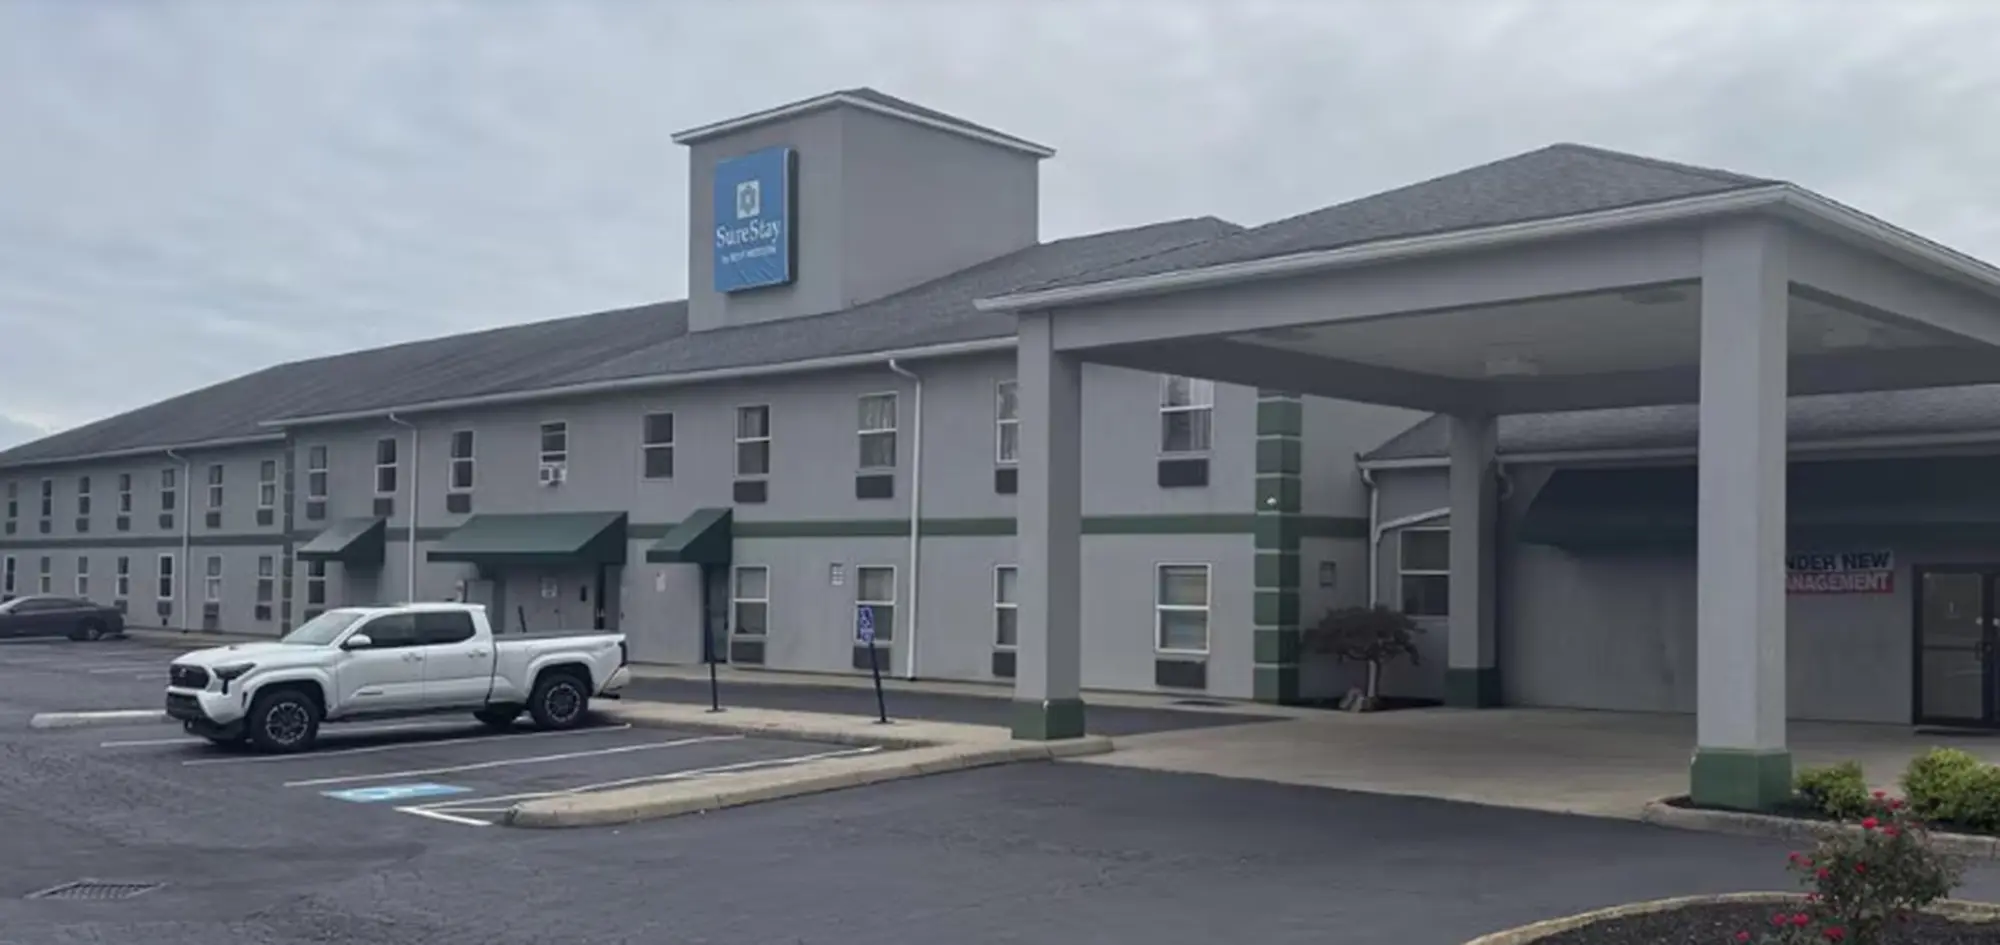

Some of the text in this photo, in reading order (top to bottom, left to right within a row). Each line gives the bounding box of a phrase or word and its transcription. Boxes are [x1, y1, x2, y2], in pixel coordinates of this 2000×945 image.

[1786, 552, 1890, 570] NDER NEW
[1786, 572, 1889, 591] ANAGEMENT
